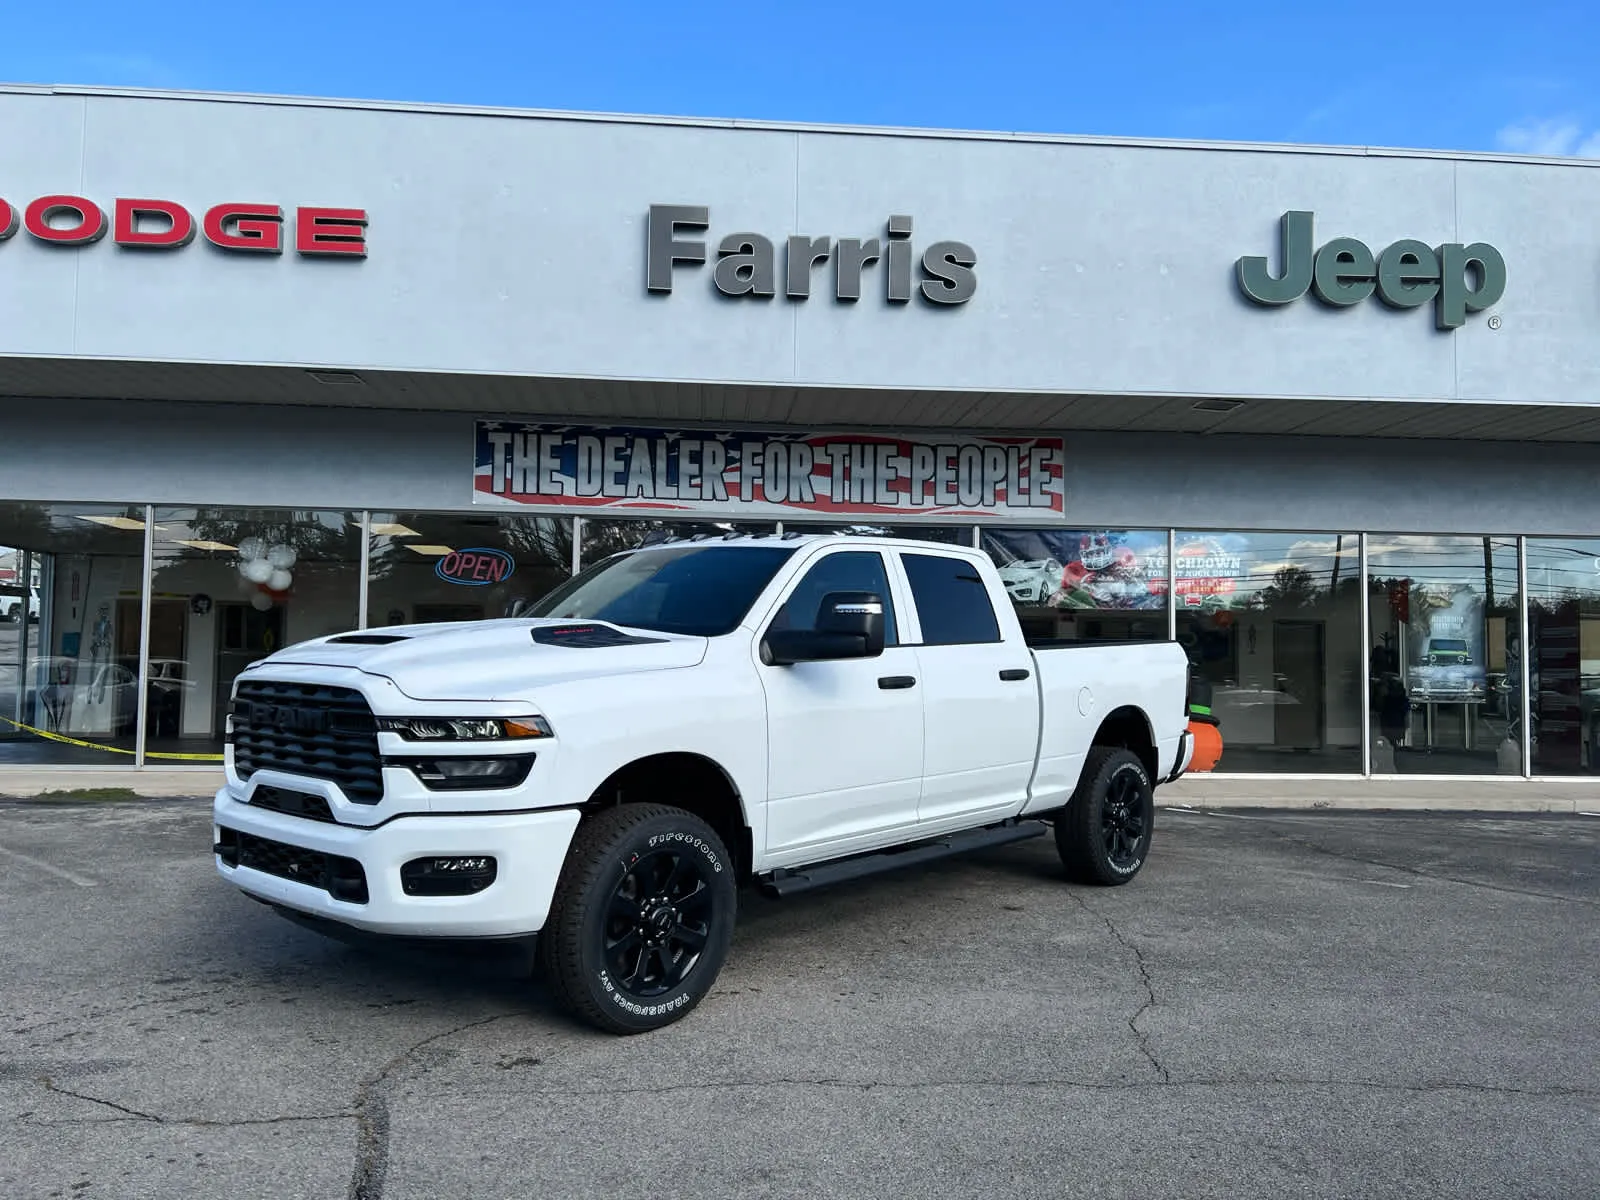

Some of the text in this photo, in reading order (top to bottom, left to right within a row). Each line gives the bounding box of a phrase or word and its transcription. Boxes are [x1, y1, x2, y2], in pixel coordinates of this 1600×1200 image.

[0, 194, 369, 259] ODGE
[647, 203, 977, 304] Farris
[1235, 210, 1507, 329] Jeep
[488, 431, 1054, 507] THE DEALER FOR THE PEOPLE
[442, 551, 506, 582] OPEN
[1146, 556, 1241, 569] TOCHDOWN
[251, 702, 329, 732] RAM
